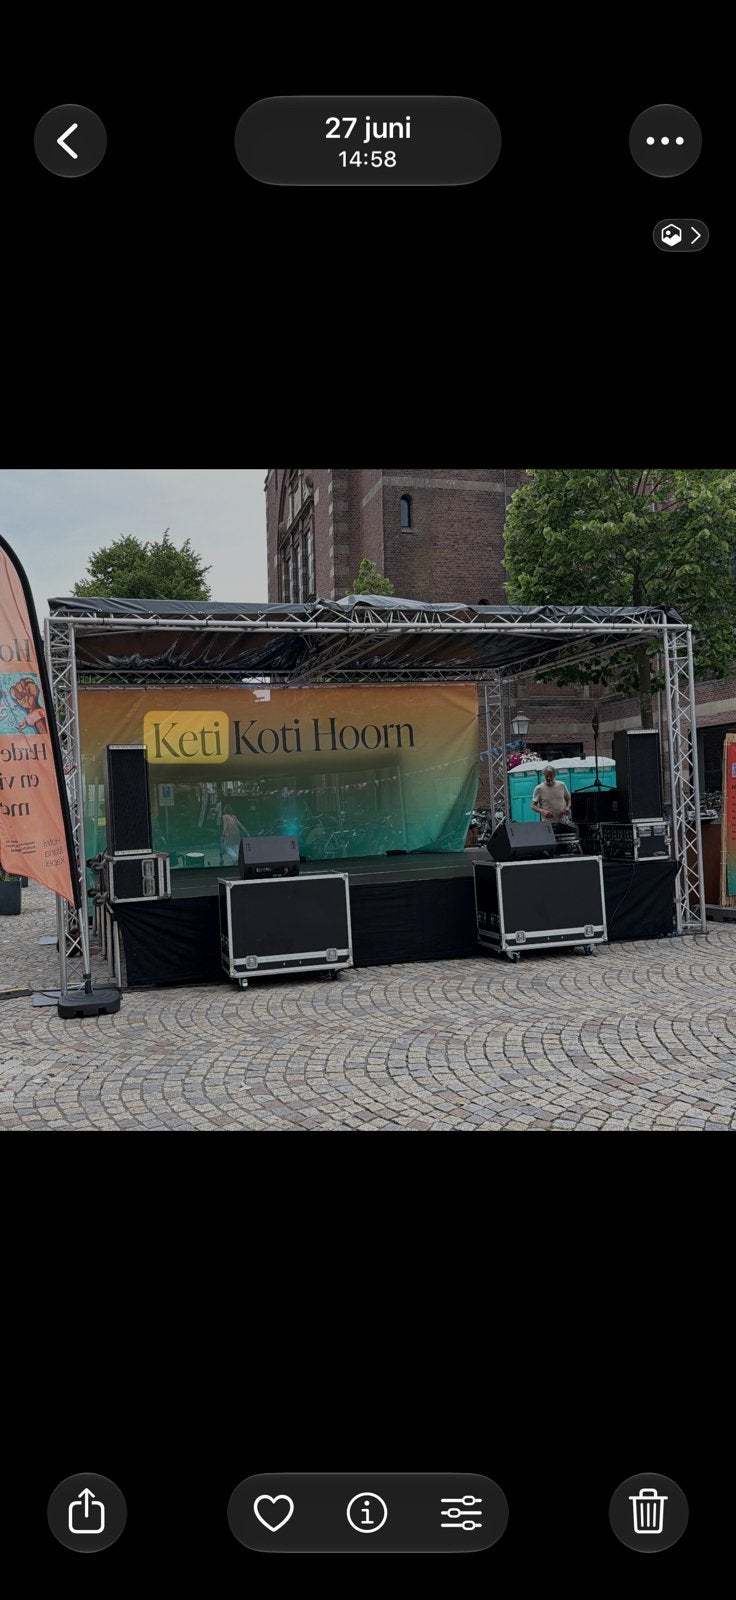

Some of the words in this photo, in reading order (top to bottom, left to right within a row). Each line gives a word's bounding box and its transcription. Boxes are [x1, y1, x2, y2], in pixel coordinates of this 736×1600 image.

[152, 720, 225, 759] Keti
[232, 718, 302, 756] Koti
[312, 717, 415, 752] Hoorn
